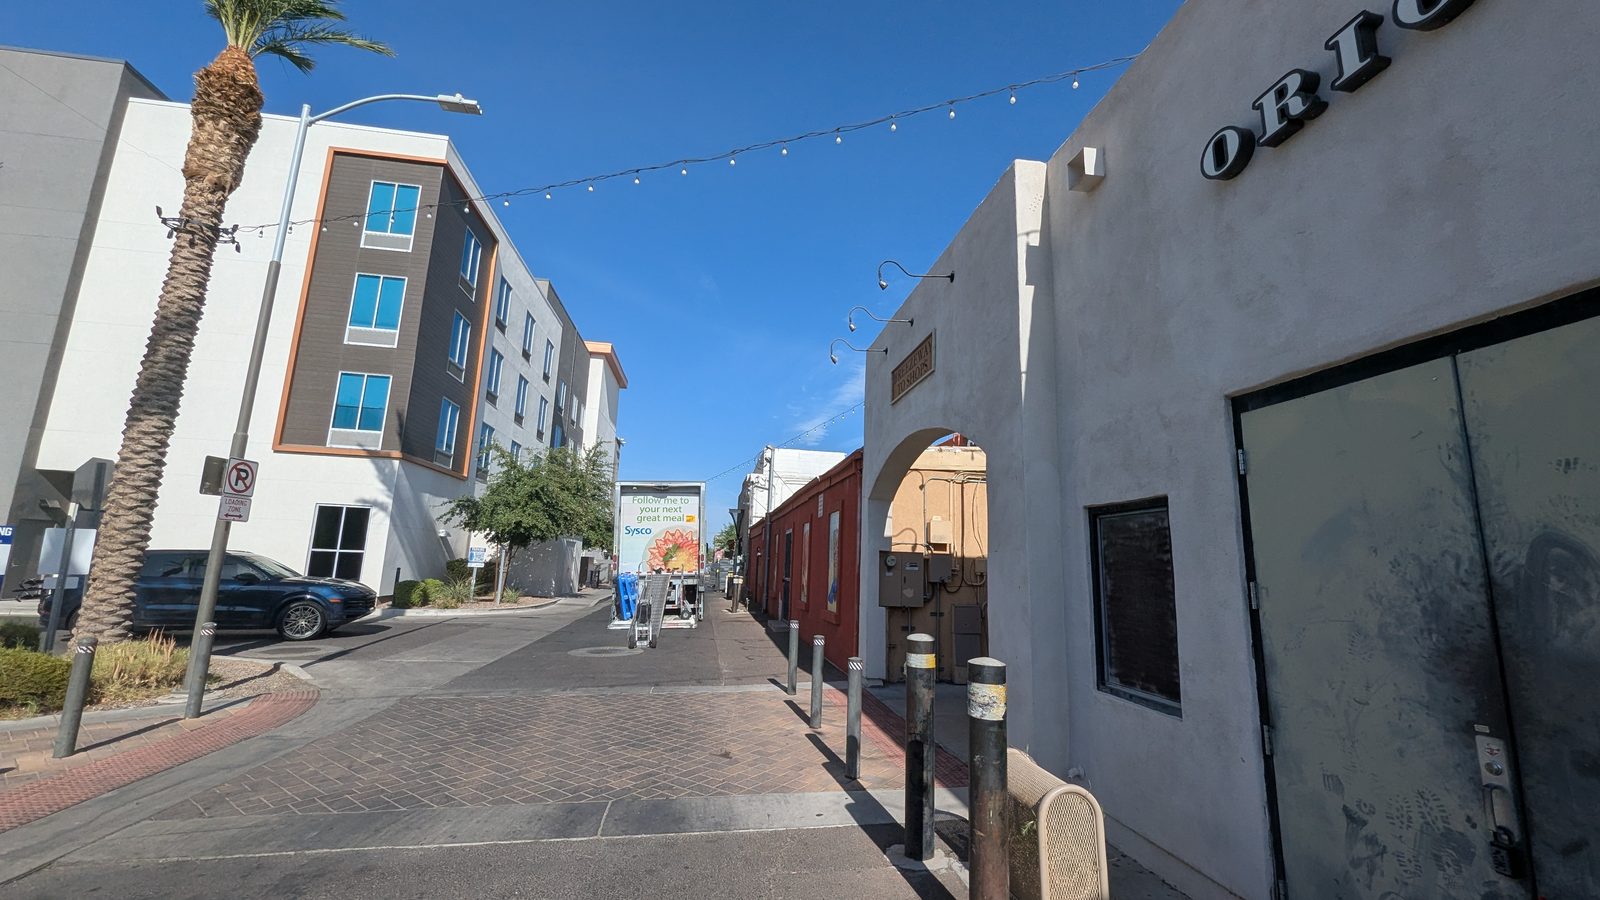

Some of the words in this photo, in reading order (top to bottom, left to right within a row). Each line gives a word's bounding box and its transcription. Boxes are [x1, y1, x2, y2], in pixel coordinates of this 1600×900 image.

[906, 358, 928, 389] SHOPS
[225, 498, 248, 506] LOADING
[632, 496, 661, 504] Follow
[640, 506, 660, 515] your
[637, 514, 661, 524] great
[663, 514, 684, 522] meal
[625, 526, 652, 536] Sysco
